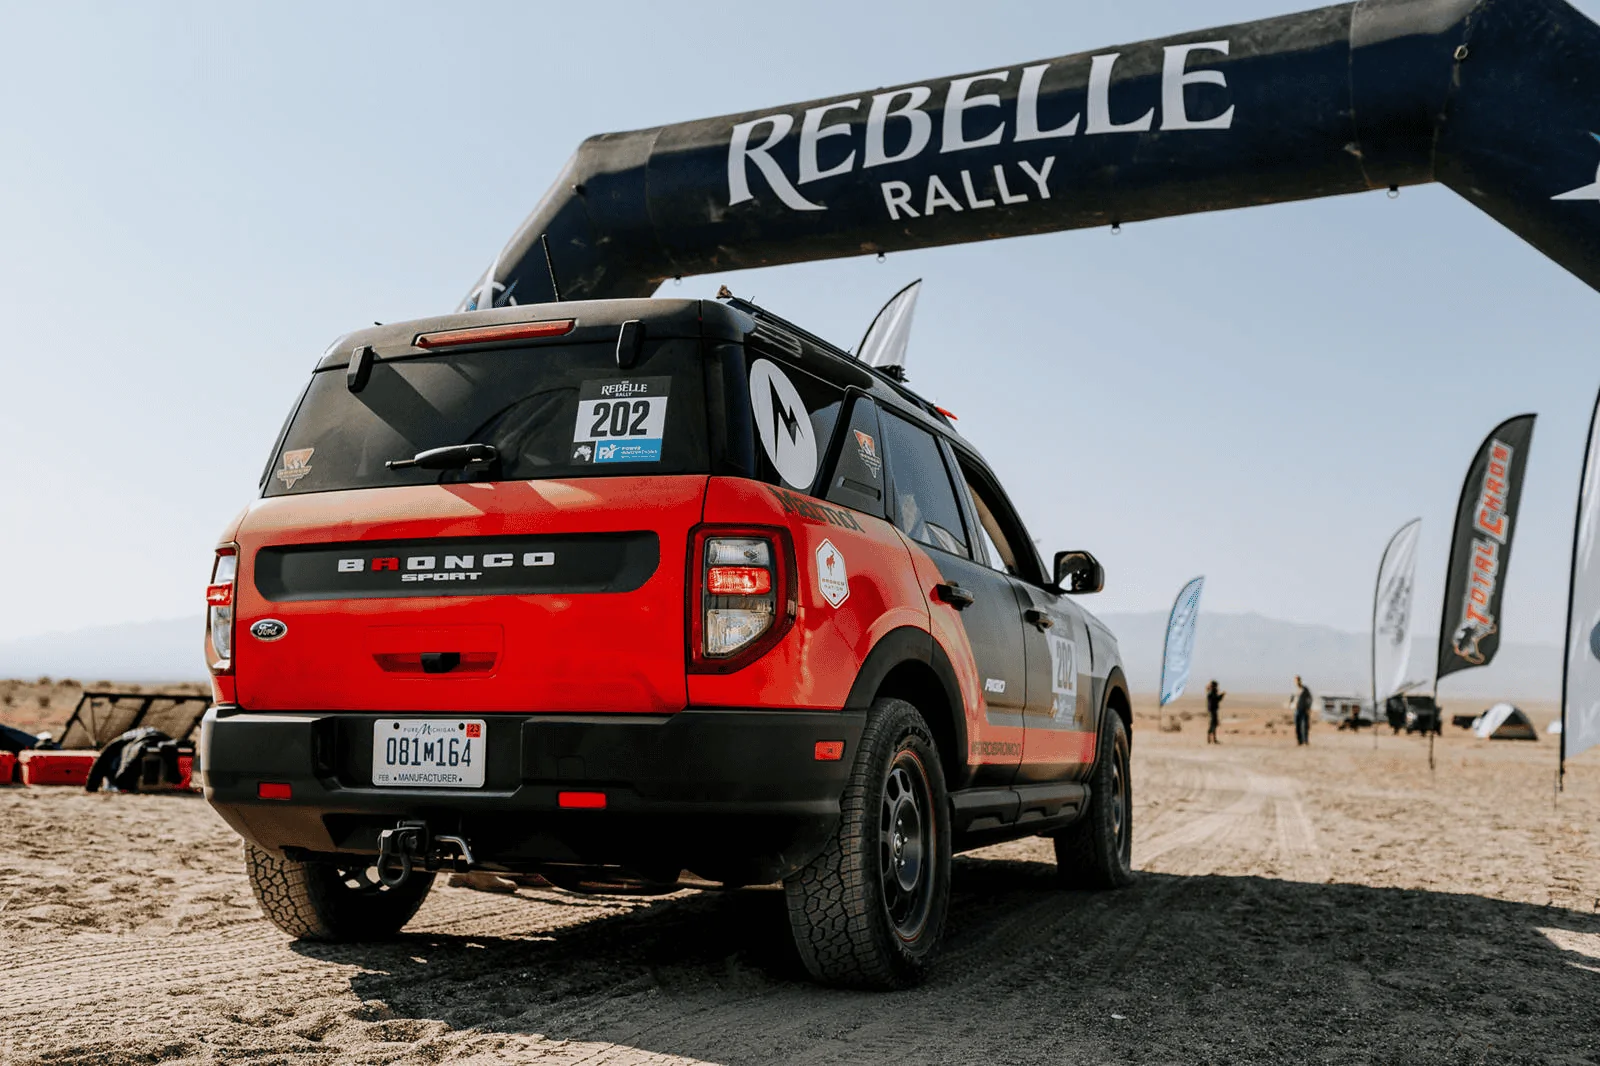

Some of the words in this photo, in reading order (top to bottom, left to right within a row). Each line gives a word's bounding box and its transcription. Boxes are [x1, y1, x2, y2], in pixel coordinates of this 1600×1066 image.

[728, 40, 1235, 211] REBELLE
[881, 155, 1056, 221] RALLY
[601, 384, 648, 395] REBELLE
[590, 401, 650, 437] 202
[1474, 440, 1512, 543] CHAOS
[338, 552, 555, 572] BRONCO
[401, 572, 483, 582] SPORT
[1464, 539, 1498, 627] TOTAL
[257, 623, 278, 636] Ford
[1056, 640, 1074, 691] 202
[386, 737, 472, 767] 081M164
[398, 773, 458, 783] MANUFACTURER
